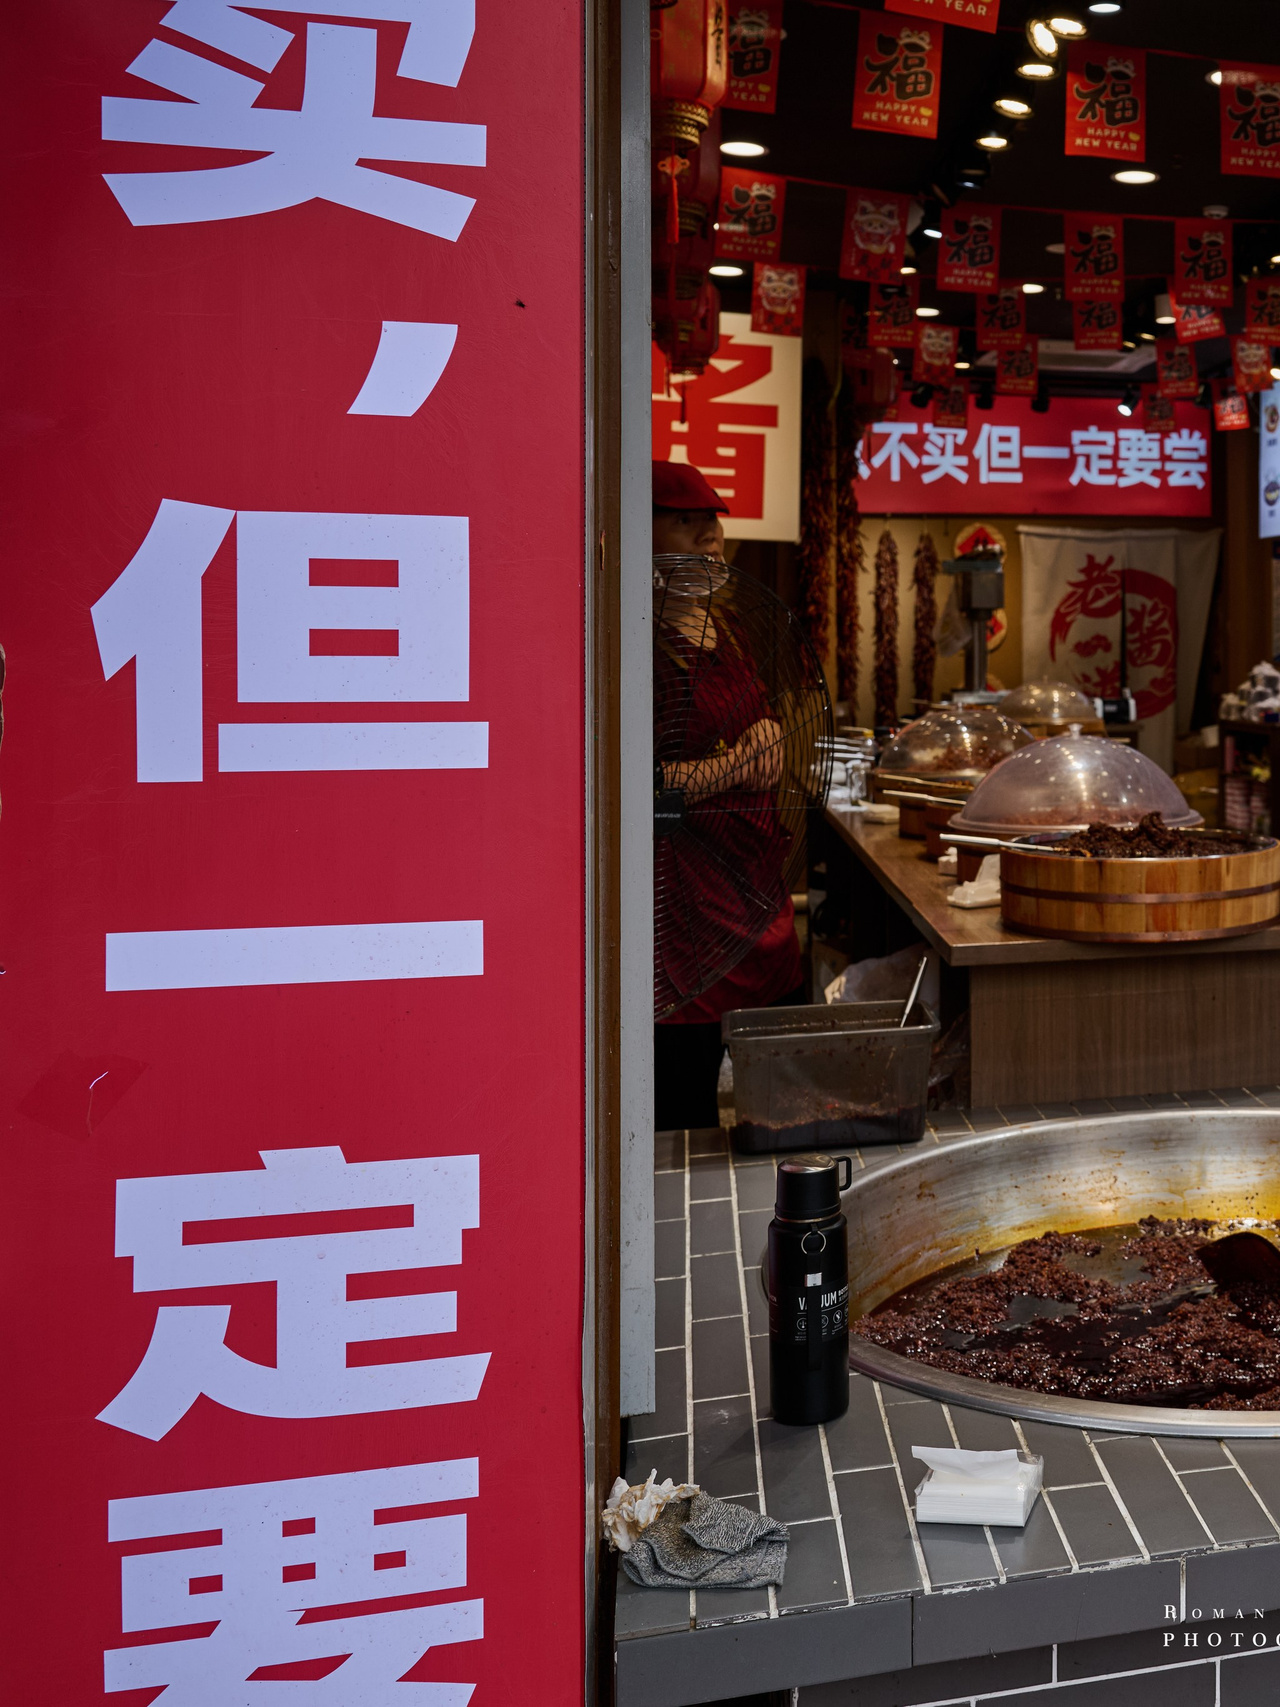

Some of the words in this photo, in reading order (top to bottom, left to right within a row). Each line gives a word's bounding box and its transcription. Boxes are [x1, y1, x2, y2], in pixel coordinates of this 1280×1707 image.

[864, 32, 932, 101] 福
[876, 100, 917, 113] HAPPY
[1074, 60, 1140, 126] 福
[862, 111, 892, 123] NEW
[899, 114, 930, 127] YEAR
[1087, 127, 1126, 139] HAPPY
[1075, 137, 1101, 149] NEW
[1106, 140, 1138, 152] YEAR
[1241, 148, 1277, 159] HAPPY
[1230, 156, 1254, 167] NEW
[724, 184, 777, 236] 福
[946, 218, 994, 268] 福
[1070, 229, 1118, 276] 福
[1181, 236, 1228, 282] 福
